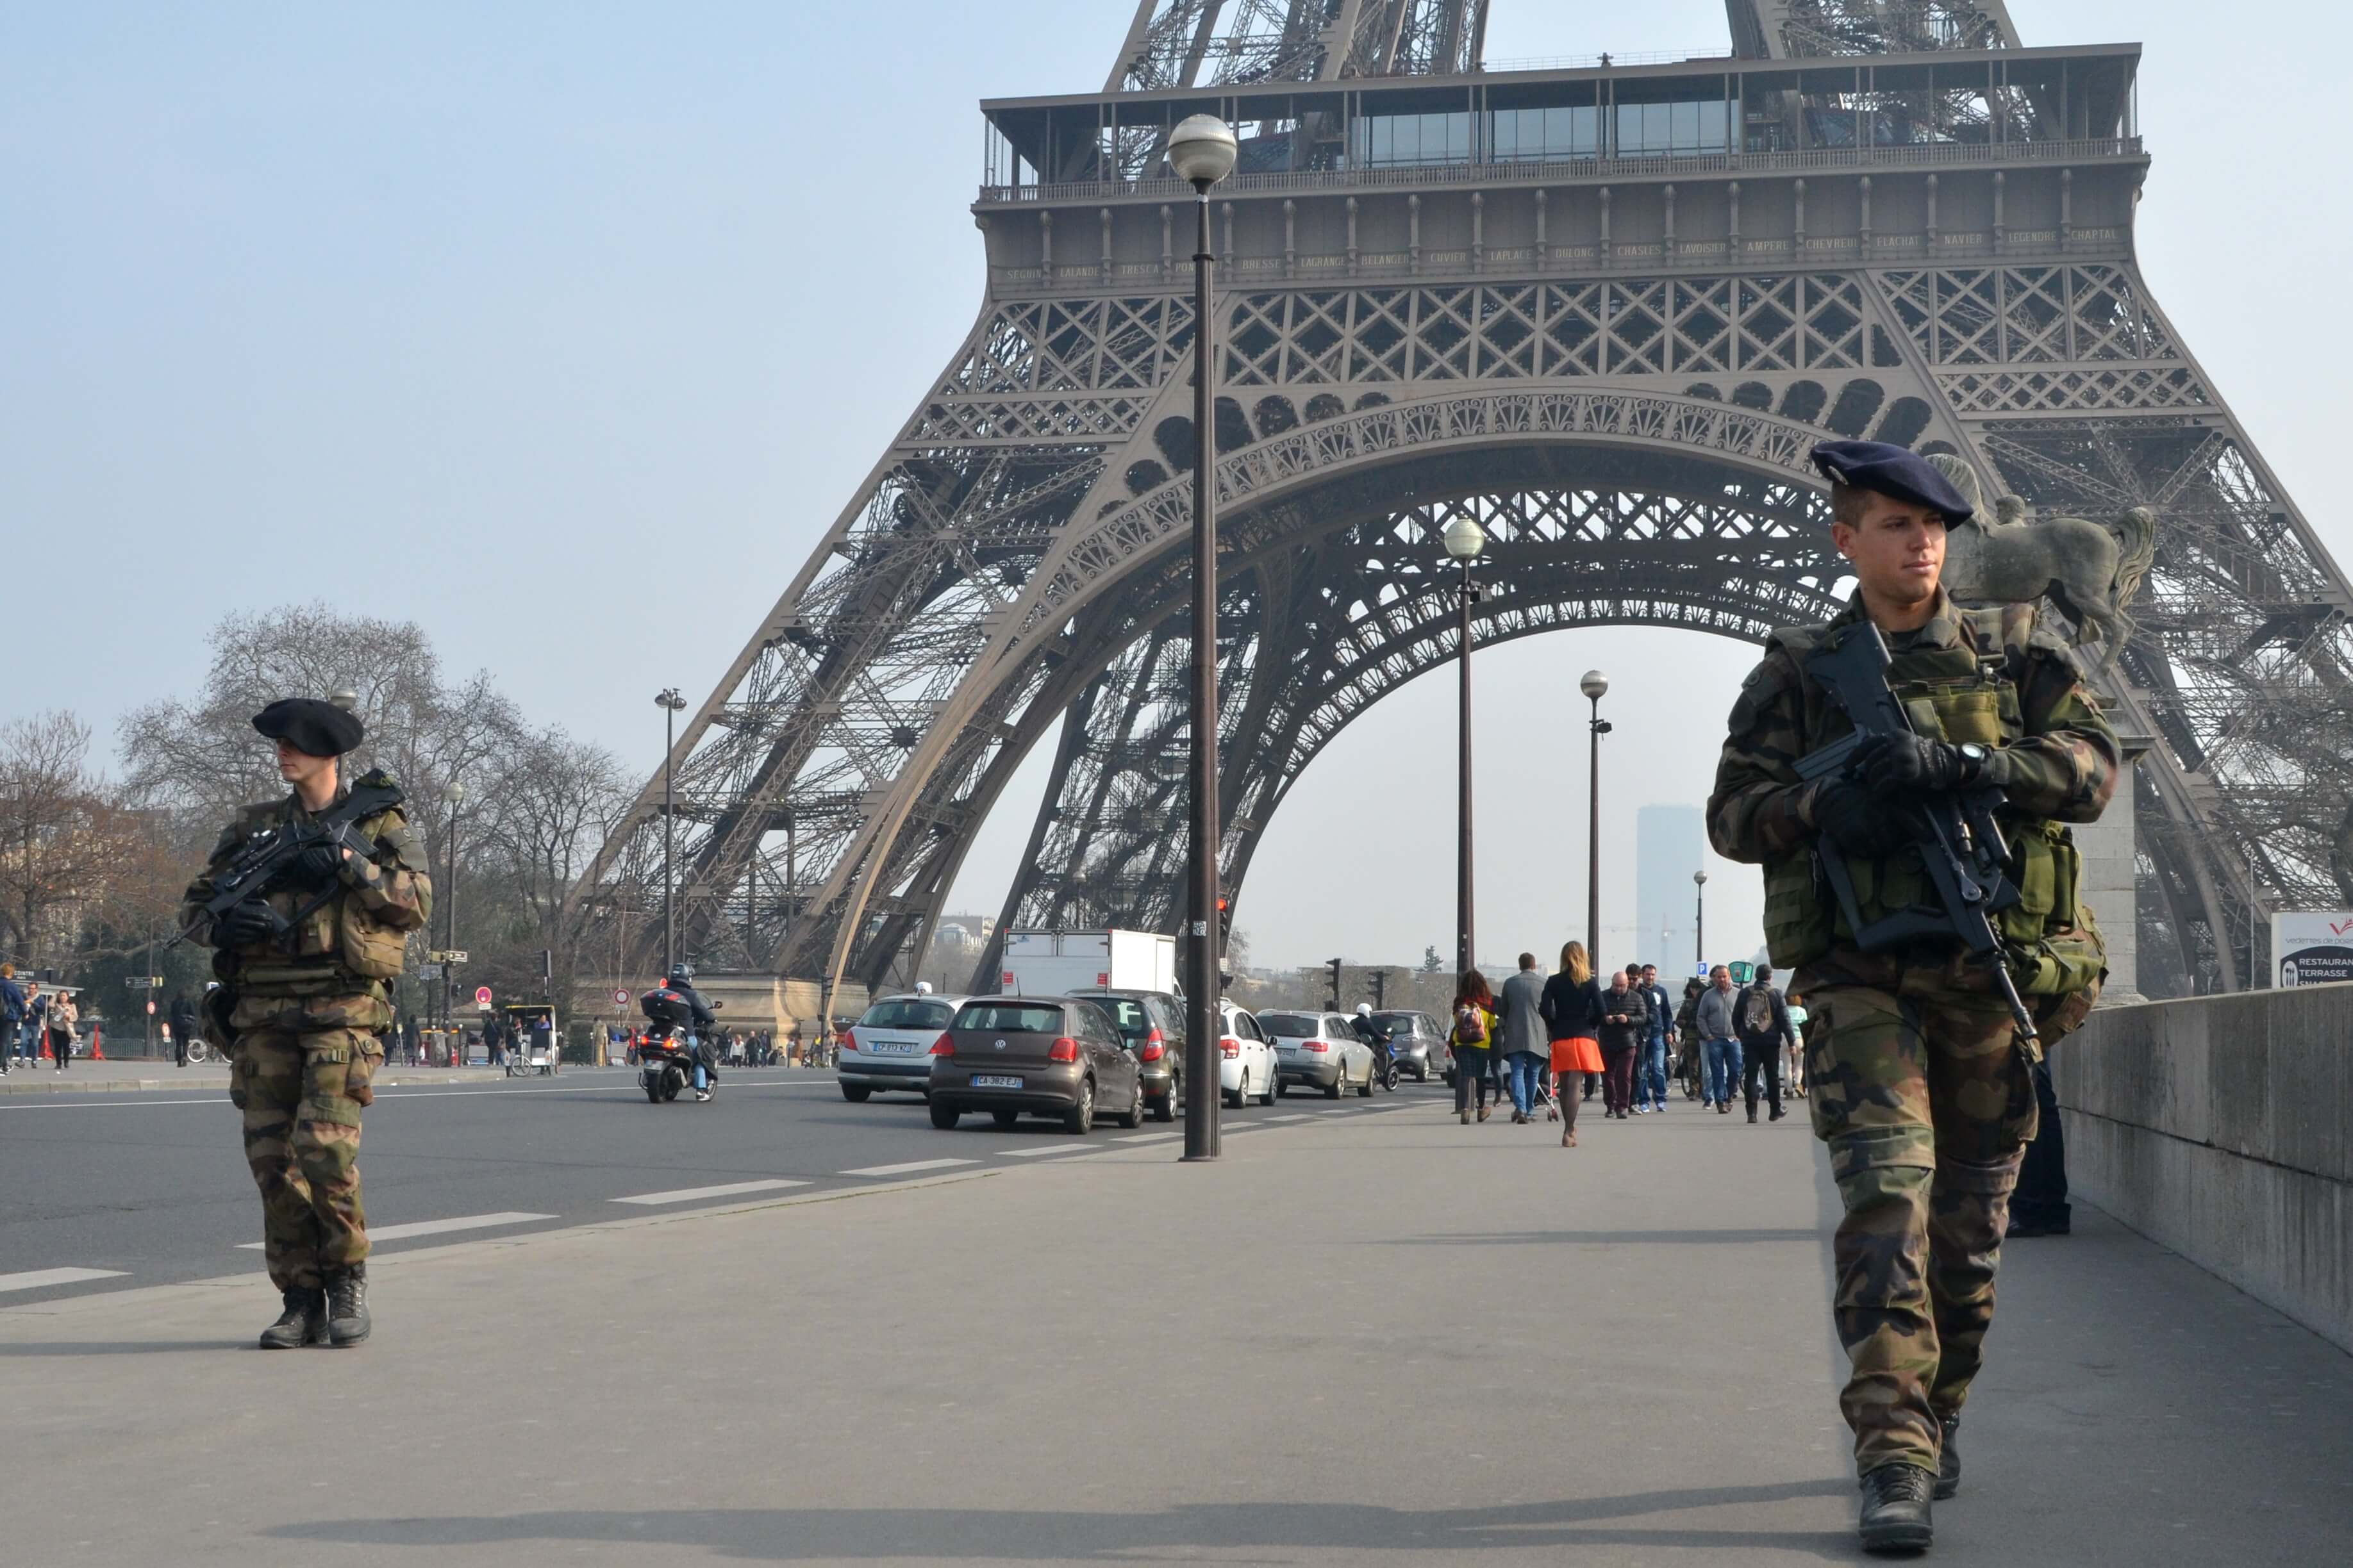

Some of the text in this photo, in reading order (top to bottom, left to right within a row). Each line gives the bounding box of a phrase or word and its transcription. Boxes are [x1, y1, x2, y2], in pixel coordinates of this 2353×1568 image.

[1944, 234, 1983, 245] NAVIER
[2009, 231, 2057, 243] LEGENDRE
[2072, 229, 2118, 240] CHAPTAL
[1747, 240, 1788, 252] AMPERE
[1806, 238, 1858, 249] CHEVREUL
[1877, 235, 1918, 247] FLACHAT
[1555, 247, 1594, 258] DULONG
[1617, 245, 1661, 256] CHASLES
[1679, 243, 1726, 254] LAVOISIER
[1430, 252, 1467, 262] CUVIER
[1491, 250, 1532, 261] LAPLACE
[1242, 258, 1280, 269] BRESSE
[1301, 256, 1345, 267] LAGRANGE
[1060, 266, 1099, 277] LALANDE
[1122, 264, 1159, 276] TRESCA
